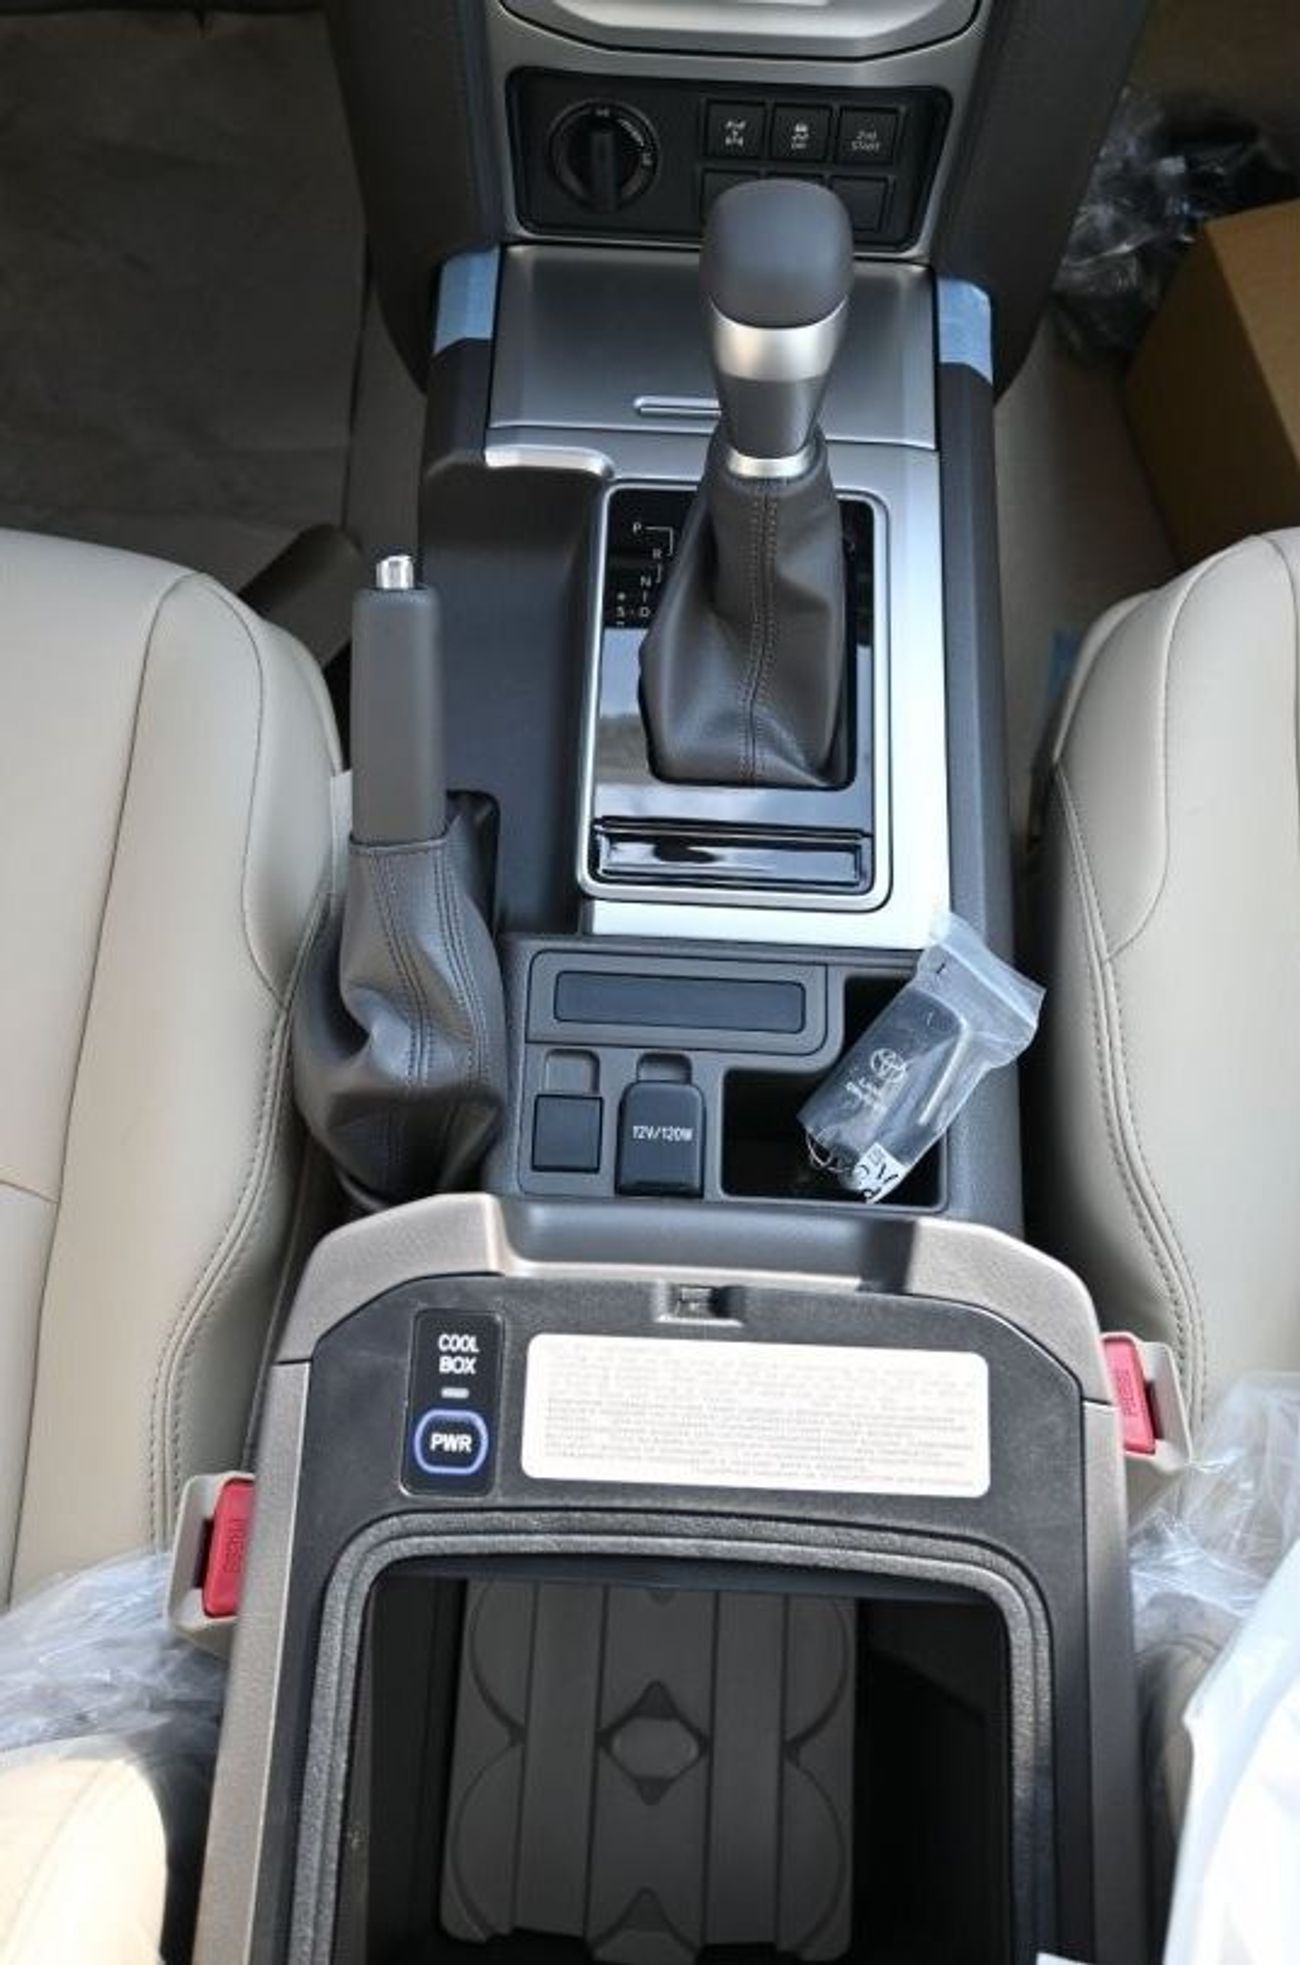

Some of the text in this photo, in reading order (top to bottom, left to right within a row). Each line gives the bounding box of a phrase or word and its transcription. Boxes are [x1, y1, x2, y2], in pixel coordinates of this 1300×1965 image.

[632, 521, 642, 534] P
[652, 547, 663, 560] R
[640, 575, 652, 588] N
[640, 605, 651, 618] D
[632, 1125, 693, 1142] 12V/120W
[437, 1333, 480, 1353] COOL
[438, 1355, 477, 1375] BOX
[429, 1432, 473, 1453] PWR
